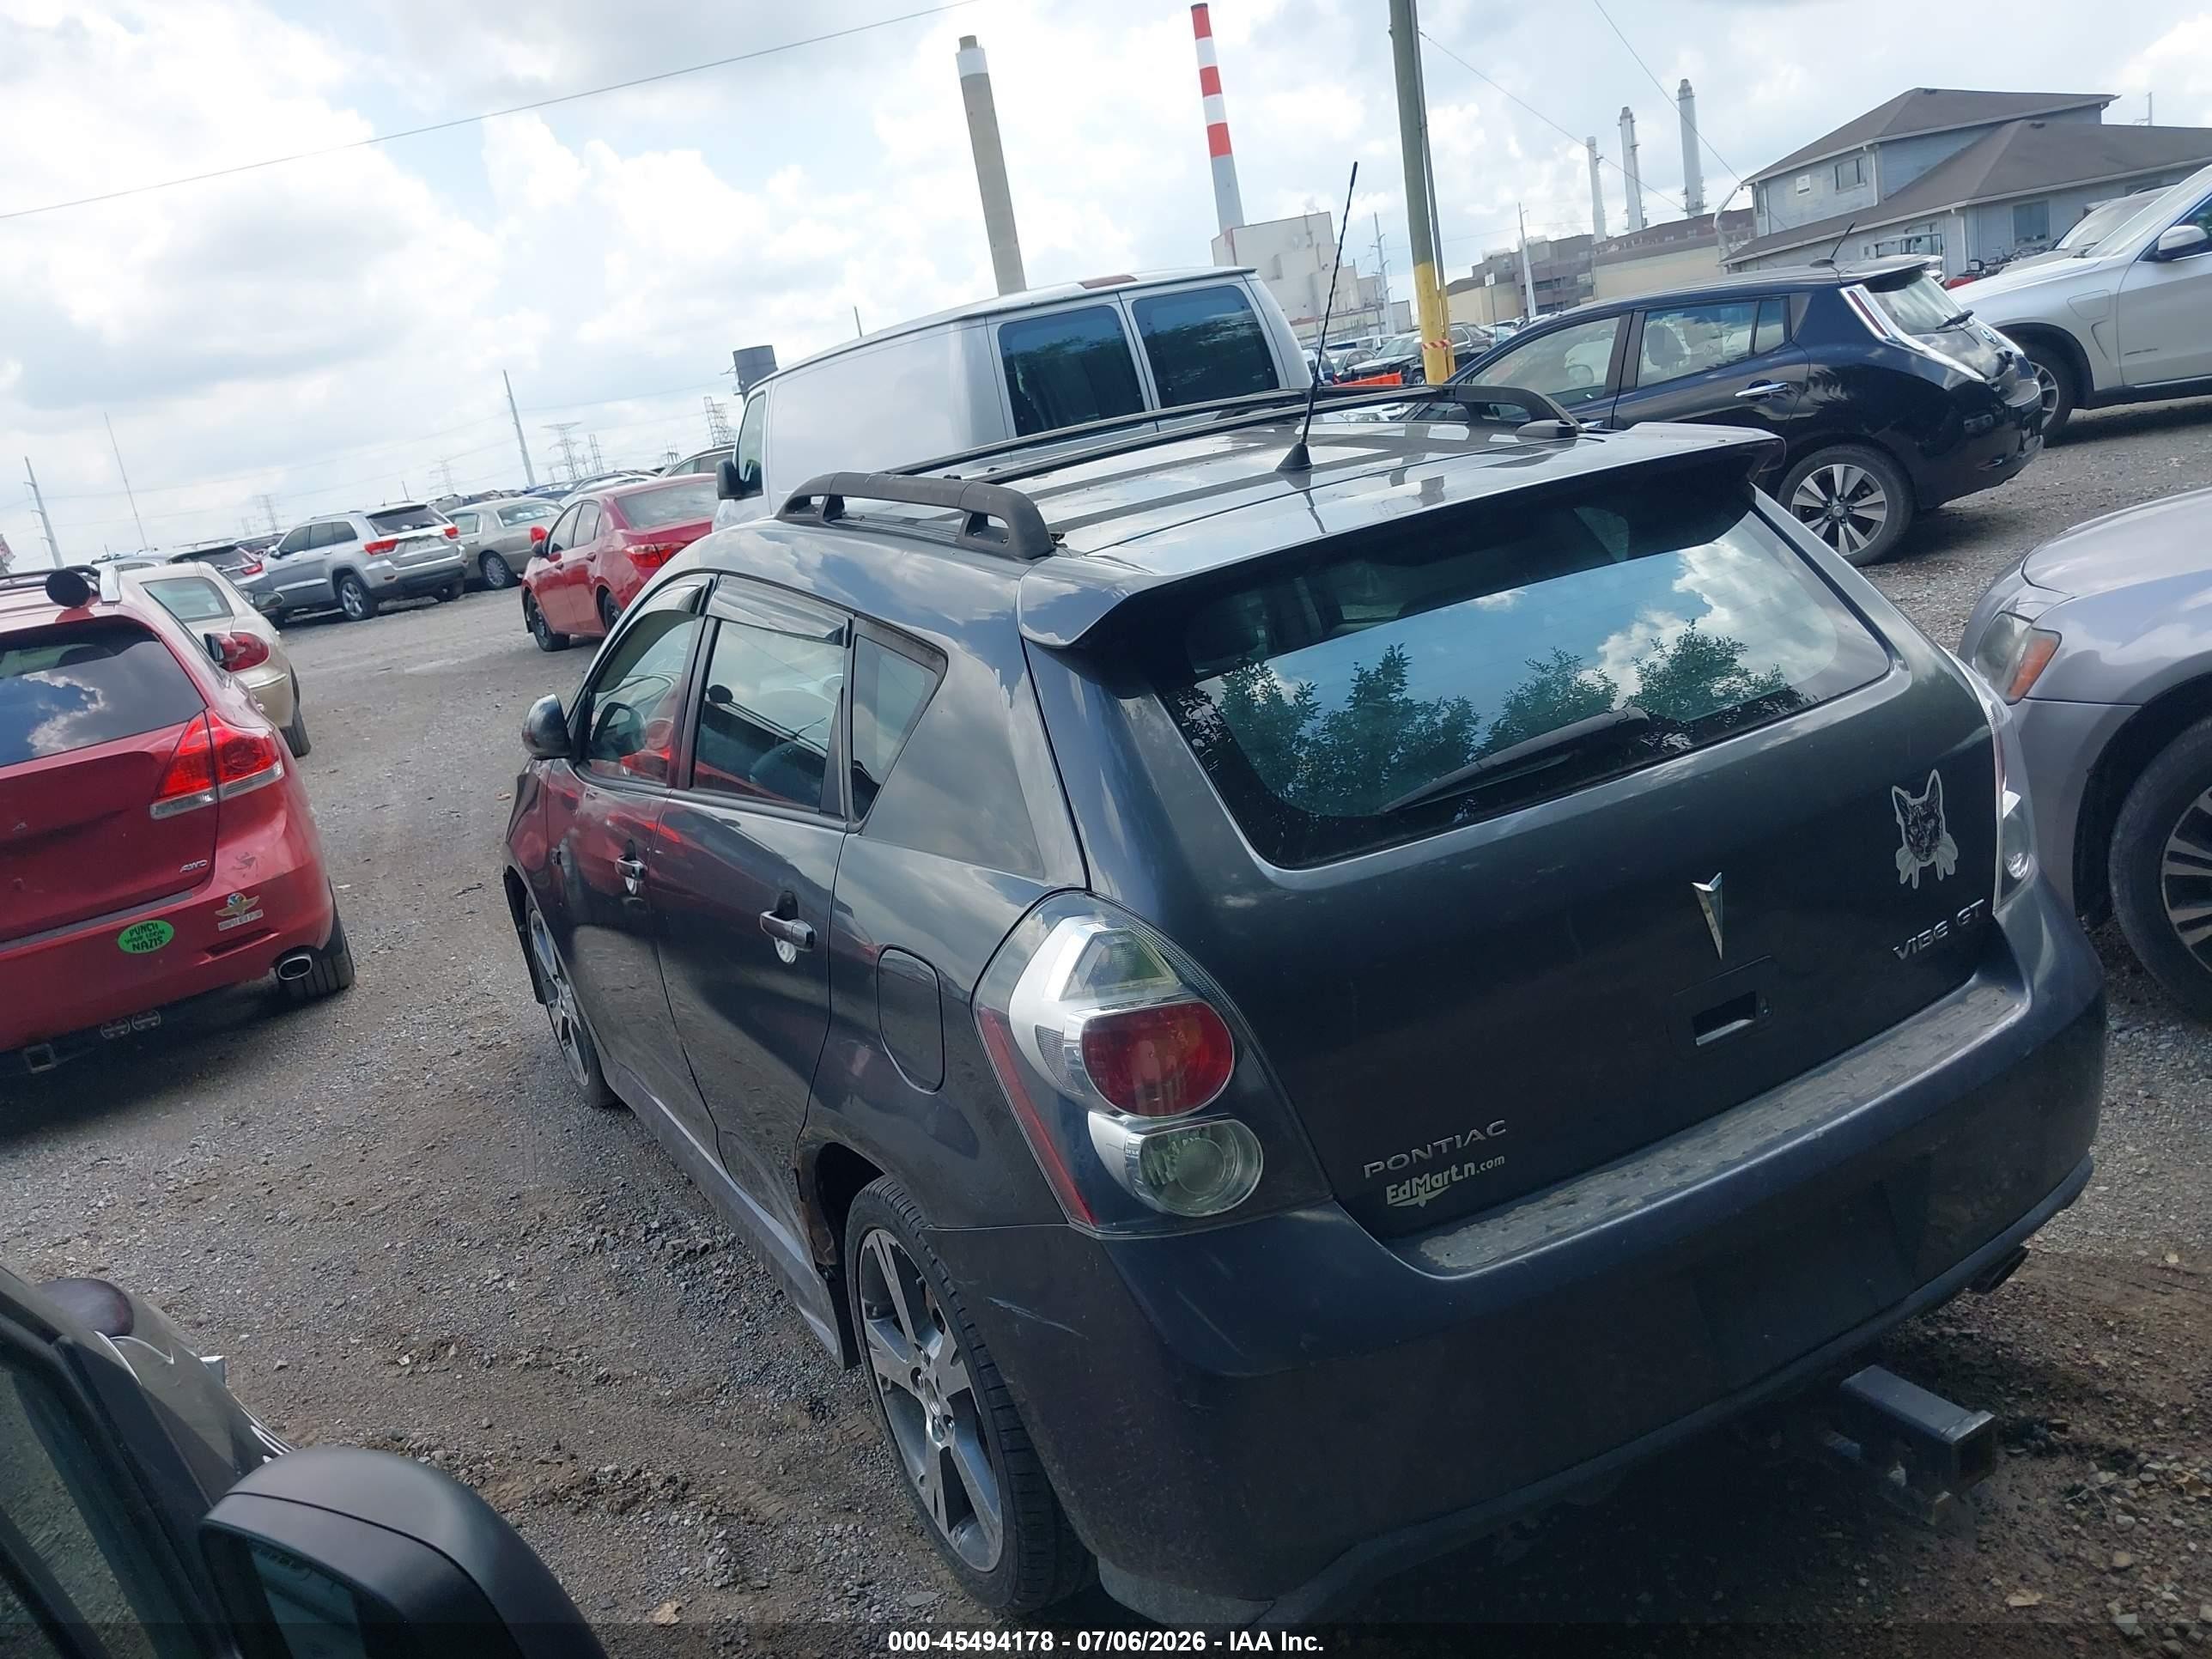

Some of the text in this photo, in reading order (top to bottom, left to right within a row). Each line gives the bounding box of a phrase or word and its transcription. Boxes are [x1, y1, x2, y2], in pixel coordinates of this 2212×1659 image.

[179, 859, 208, 872] AWD
[129, 922, 159, 936] PUNCH
[131, 935, 164, 951] NAZIS
[1892, 898, 1984, 960] VIBE GT
[1363, 1119, 1507, 1179] PONTIAC
[1385, 1155, 1506, 1206] EdMartn.com
